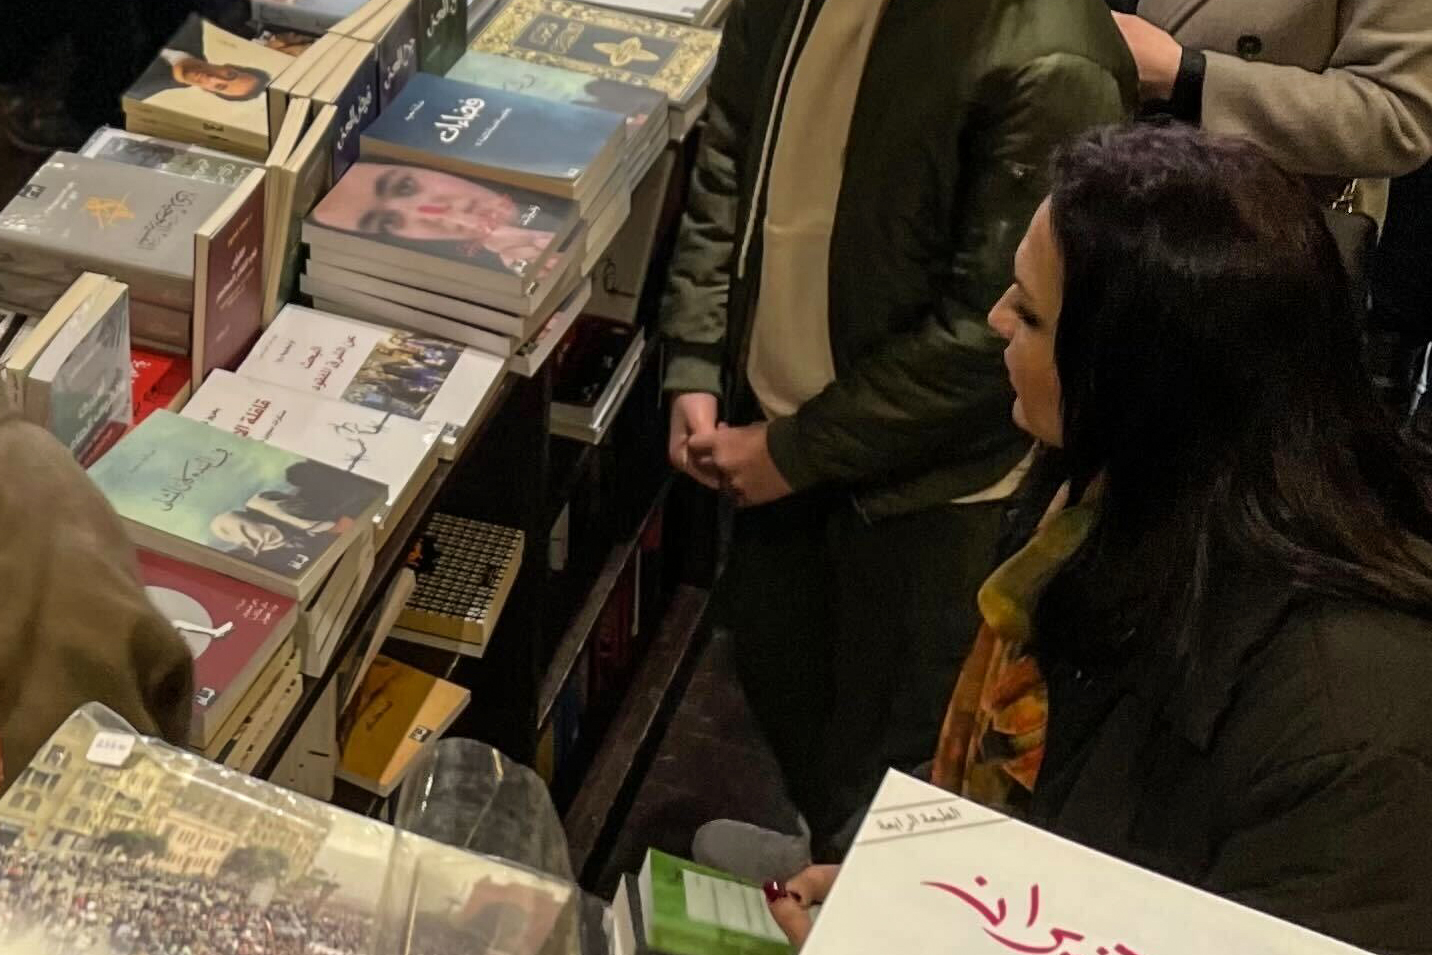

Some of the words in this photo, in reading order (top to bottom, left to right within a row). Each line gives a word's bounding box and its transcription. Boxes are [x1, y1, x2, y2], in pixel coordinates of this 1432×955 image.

[241, 398, 272, 426] قافلة
[877, 813, 917, 832] الرابعة
[920, 806, 962, 825] الطبعة
